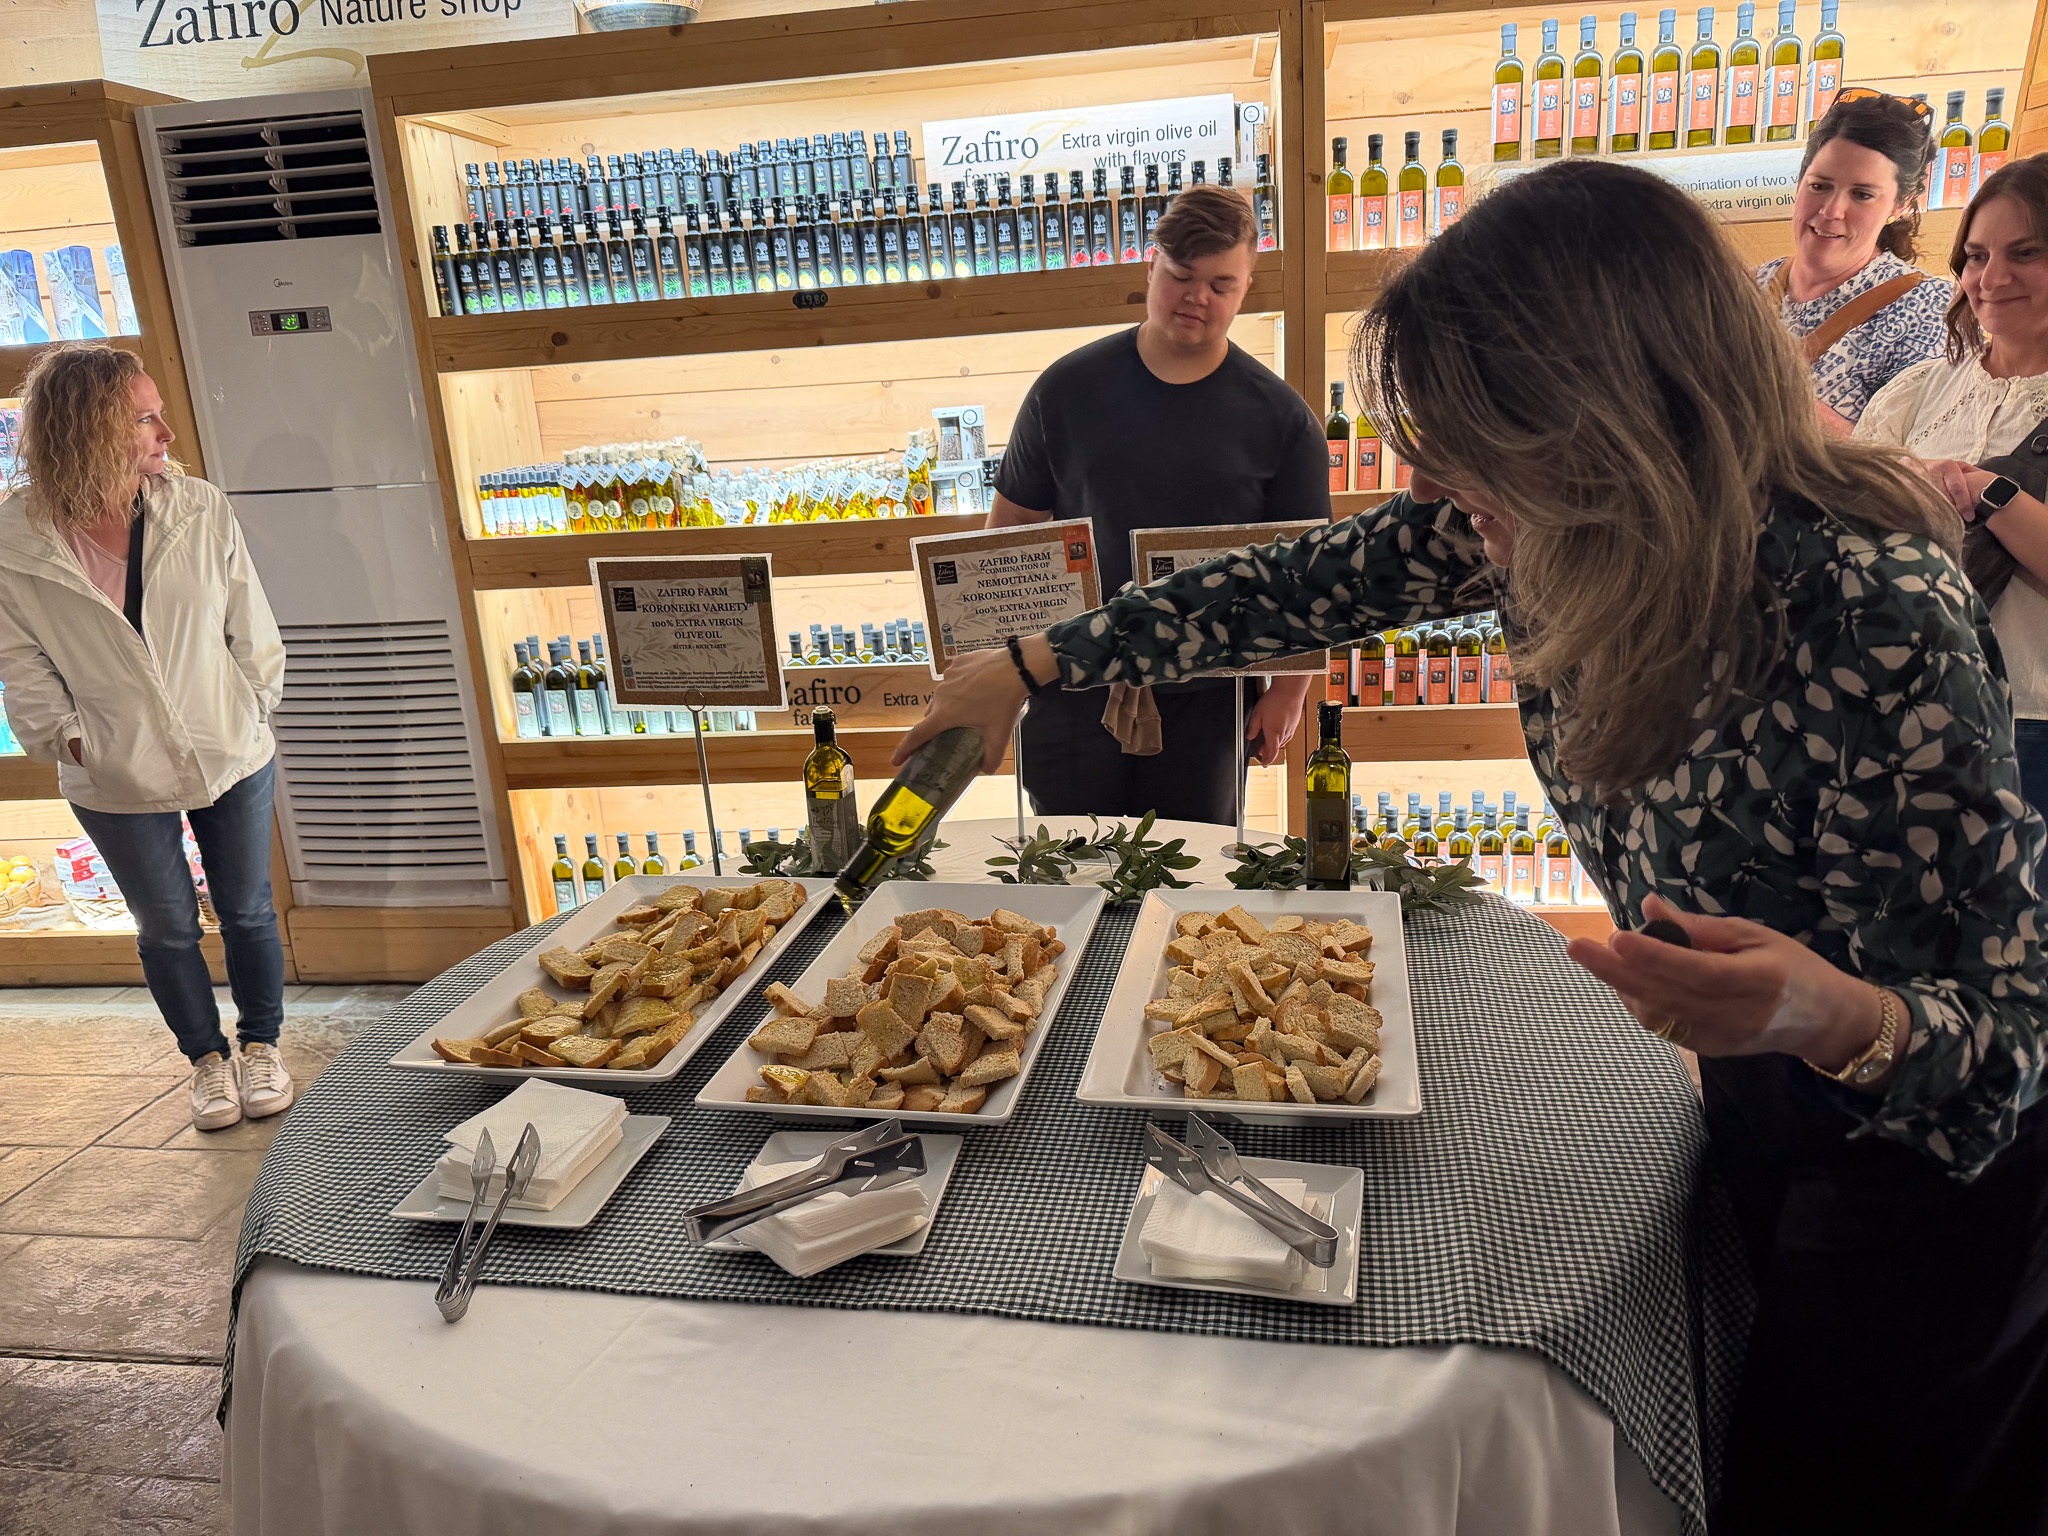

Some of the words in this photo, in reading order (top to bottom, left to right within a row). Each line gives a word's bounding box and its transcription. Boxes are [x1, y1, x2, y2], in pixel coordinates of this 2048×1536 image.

[135, 0, 299, 48] Zafiro
[320, 0, 427, 26] Nature
[1062, 133, 1100, 149] Extra
[1107, 128, 1150, 147] virgin
[1156, 124, 1192, 141] olive
[1198, 120, 1217, 137] oil
[942, 131, 1039, 166] Zafiro
[1094, 151, 1126, 168] with
[1132, 149, 1186, 166] flavors
[1746, 176, 1758, 188] of
[1762, 176, 1786, 186] two
[1736, 196, 1771, 209] virgin
[979, 556, 1018, 567] ZAFIRO
[1020, 552, 1051, 563] FARM
[977, 573, 1049, 588] NEMOUTIANA
[657, 588, 695, 597] ZAFIRO
[698, 587, 728, 596] FARM
[963, 590, 1023, 603] KORONEIKI
[637, 603, 701, 613] “KORONEIKI
[975, 606, 998, 615] 100%
[1000, 602, 1031, 612] EXTRA
[1033, 598, 1067, 609] VIRGIN
[676, 619, 707, 627] EXTRA
[709, 618, 743, 626] VIRGIN
[998, 614, 1028, 623] OLIVE
[1029, 612, 1046, 621] OIL
[675, 631, 703, 639] OLIVE
[884, 693, 919, 706] Extra
[793, 709, 837, 726] fa
